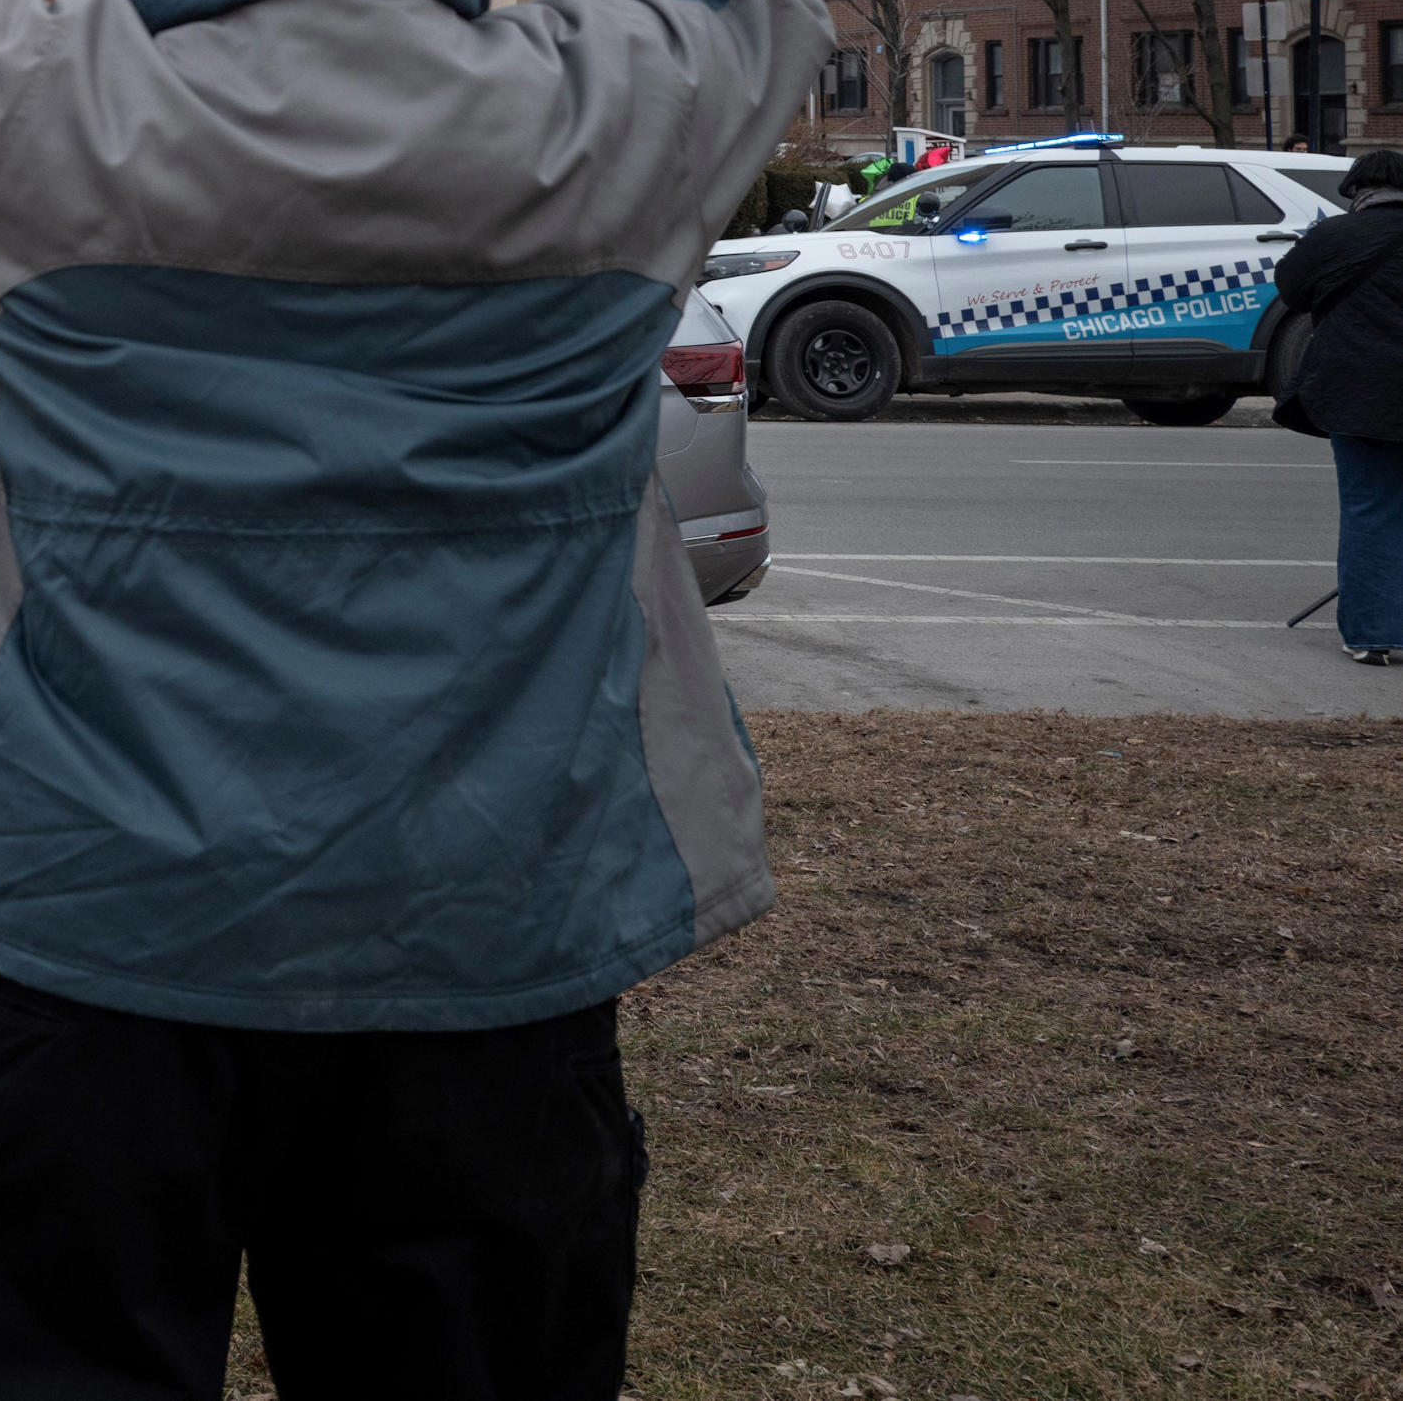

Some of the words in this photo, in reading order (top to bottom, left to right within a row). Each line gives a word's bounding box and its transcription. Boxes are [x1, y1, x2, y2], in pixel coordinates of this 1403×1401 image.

[837, 241, 910, 260] 8407
[967, 293, 986, 307] We
[991, 287, 1029, 303] Serve
[1033, 283, 1045, 295] &
[1050, 273, 1101, 292] Protect
[1062, 306, 1166, 341] CHICAGO
[1172, 289, 1261, 322] POLICE
